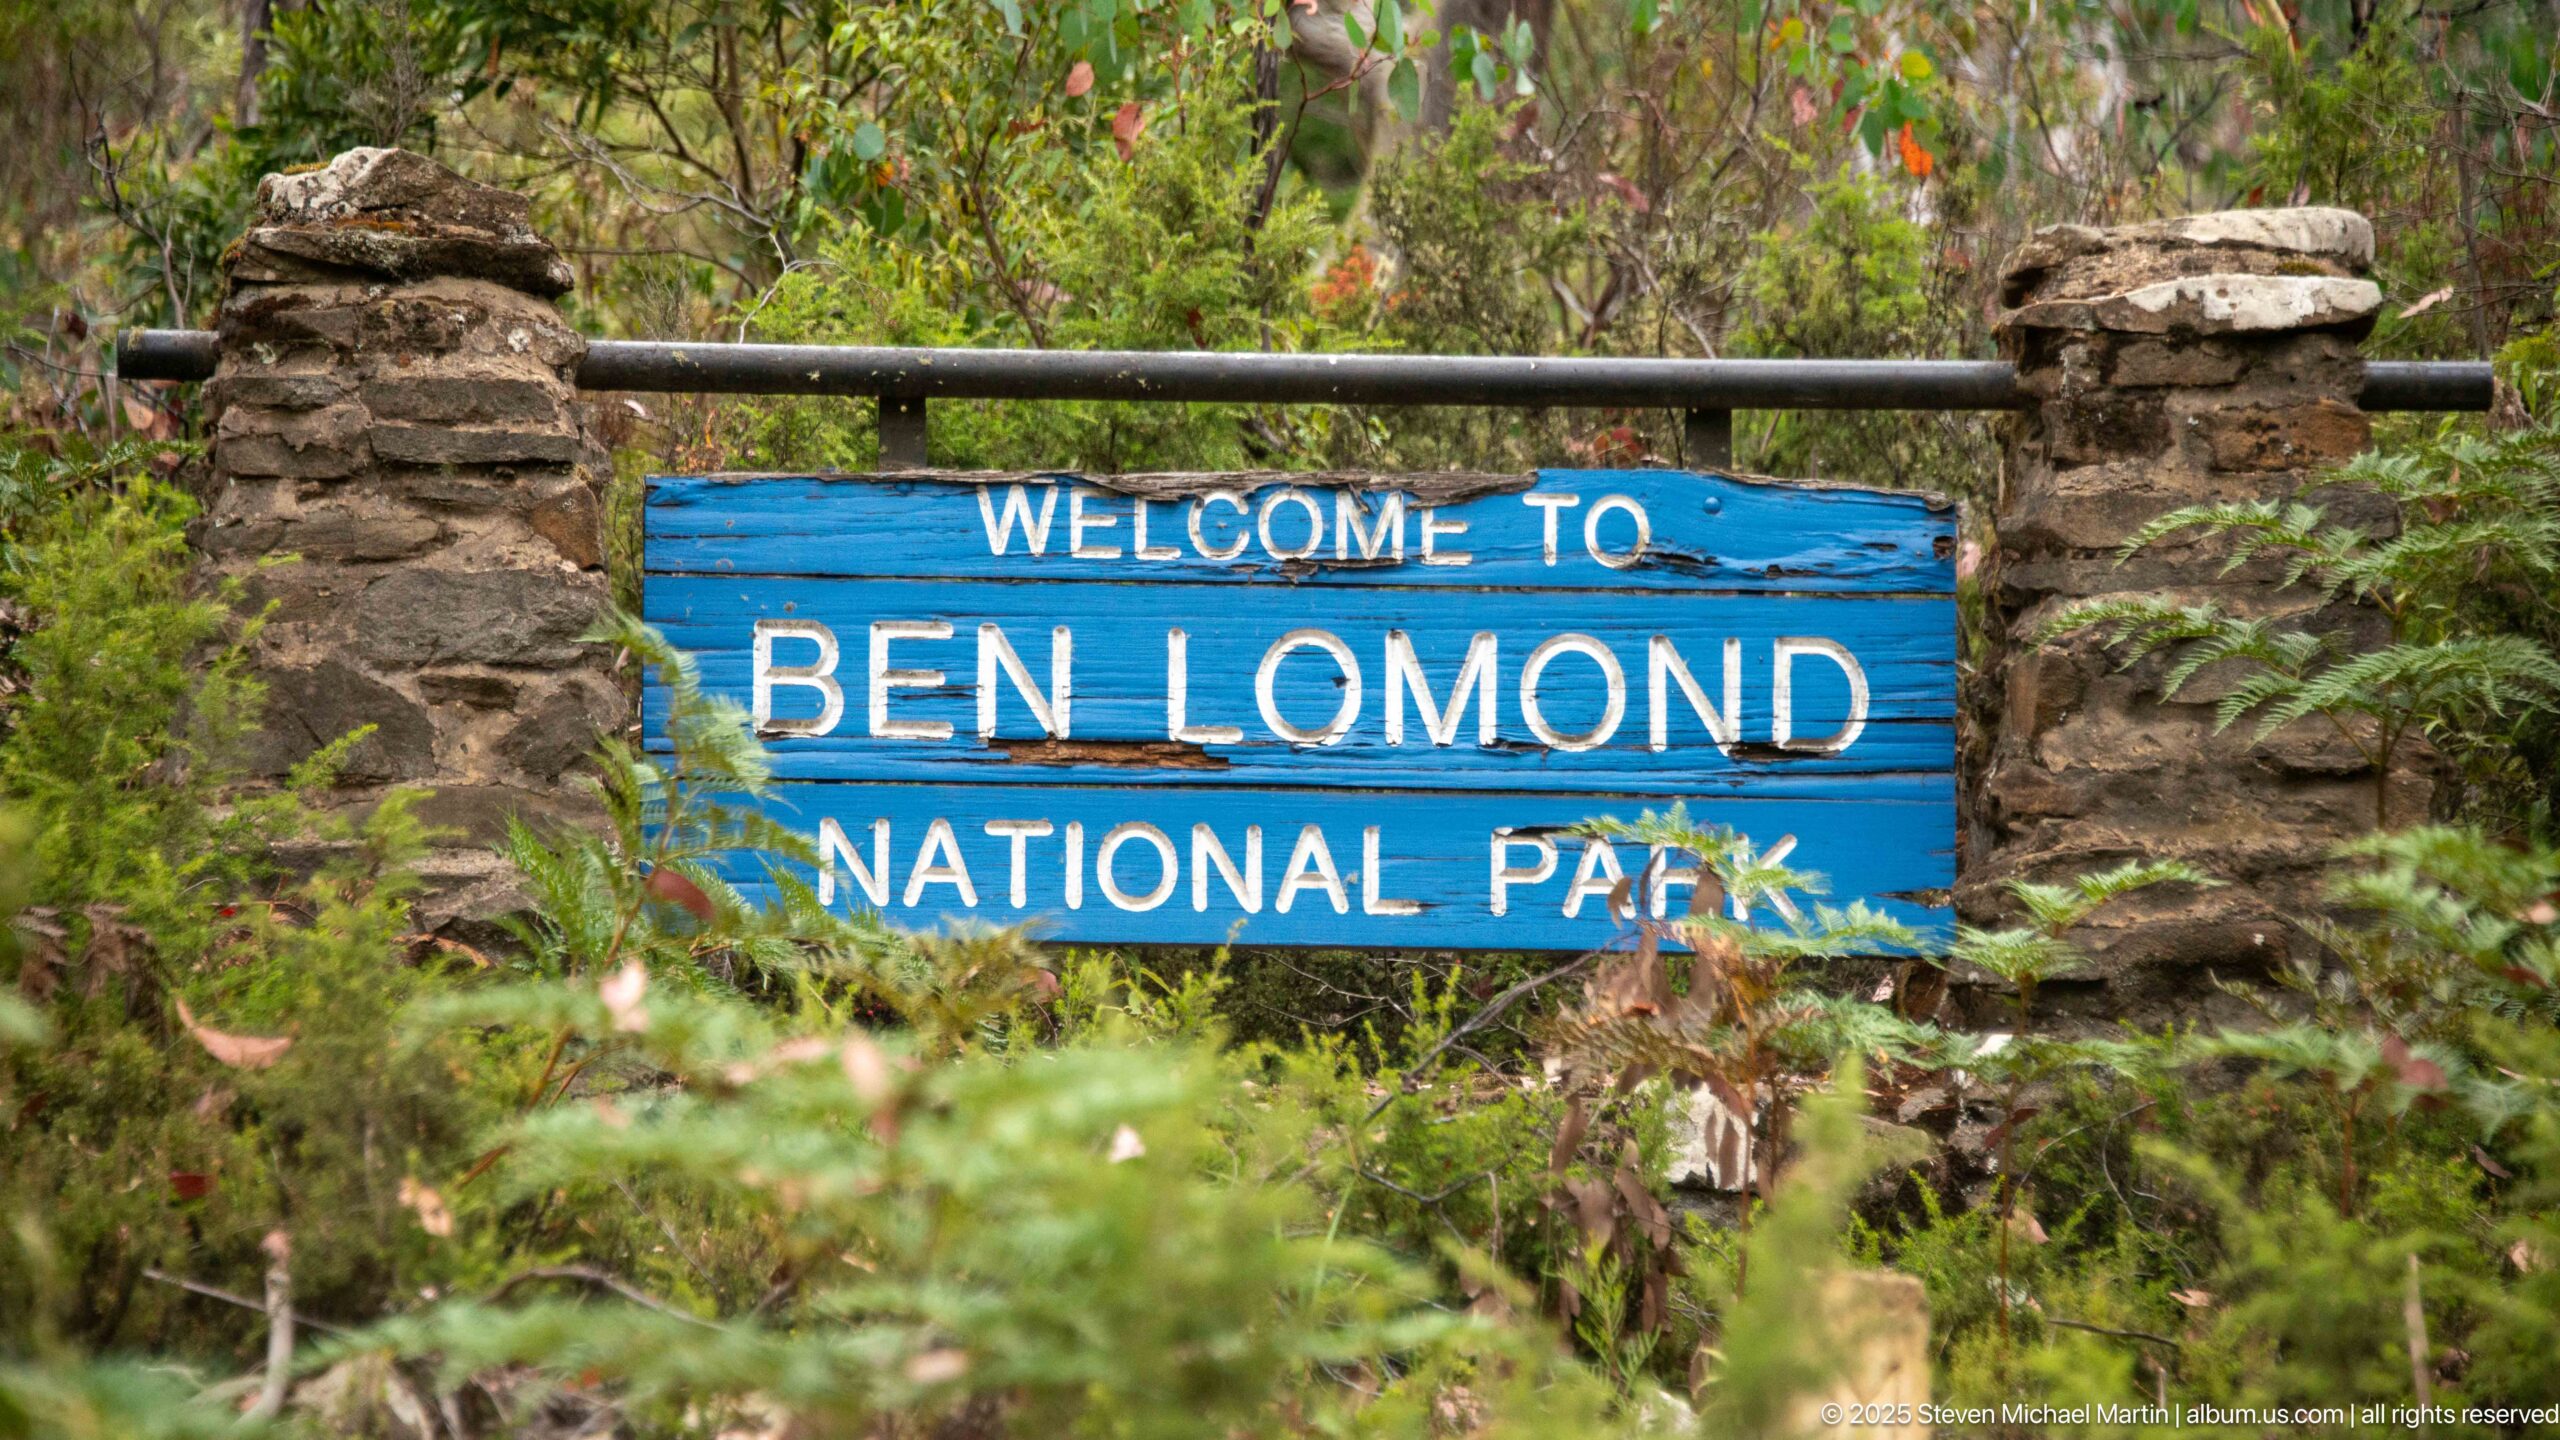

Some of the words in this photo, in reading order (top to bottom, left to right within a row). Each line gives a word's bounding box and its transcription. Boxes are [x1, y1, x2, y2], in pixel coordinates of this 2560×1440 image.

[976, 484, 1473, 566] WELCOME
[1523, 492, 1652, 569] TO
[752, 618, 1072, 740] BEN
[1167, 627, 1870, 757] LOMOND
[818, 817, 1420, 915] NATIONAL
